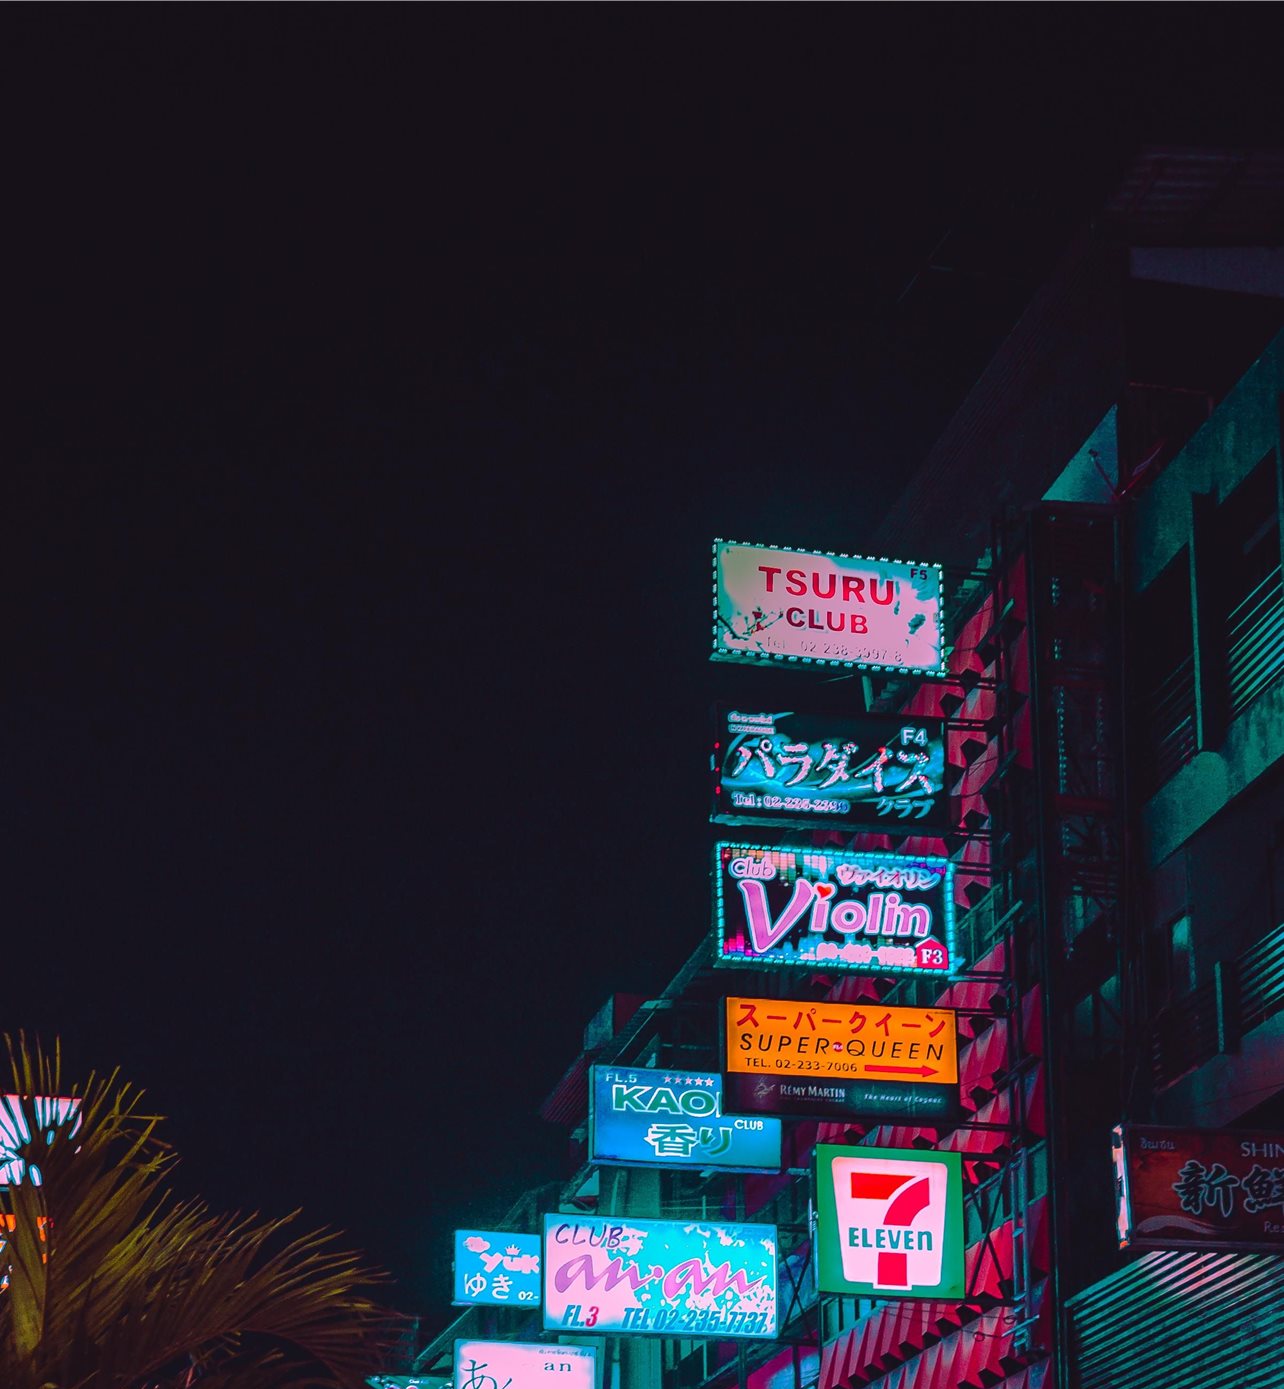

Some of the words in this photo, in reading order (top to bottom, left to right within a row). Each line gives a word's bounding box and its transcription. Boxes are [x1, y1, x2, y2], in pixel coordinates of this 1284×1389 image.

[759, 566, 894, 606] TSURU
[910, 568, 928, 580] F5
[786, 607, 868, 634] CLUB
[902, 728, 928, 745] F4
[731, 738, 935, 794] パラダイス
[876, 798, 936, 819] クラブ
[731, 858, 775, 878] Club
[740, 878, 933, 953] Violin
[921, 949, 944, 965] F3
[737, 1003, 946, 1038] スーパークイーン
[740, 1033, 830, 1055] SUPER
[846, 1039, 944, 1060] QUEEN
[745, 1057, 771, 1068] TEL.
[775, 1059, 858, 1072] 02-233-7006
[808, 1085, 845, 1098] MARTIN
[734, 1119, 764, 1131] CLUB
[645, 1122, 733, 1158] 香り
[555, 1223, 625, 1249] CLUB
[463, 1272, 514, 1299] ゆき
[562, 1304, 600, 1328] FL.3
[621, 1307, 651, 1330] TEL
[652, 1308, 769, 1335] 02-235-7737
[543, 1361, 573, 1372] an
